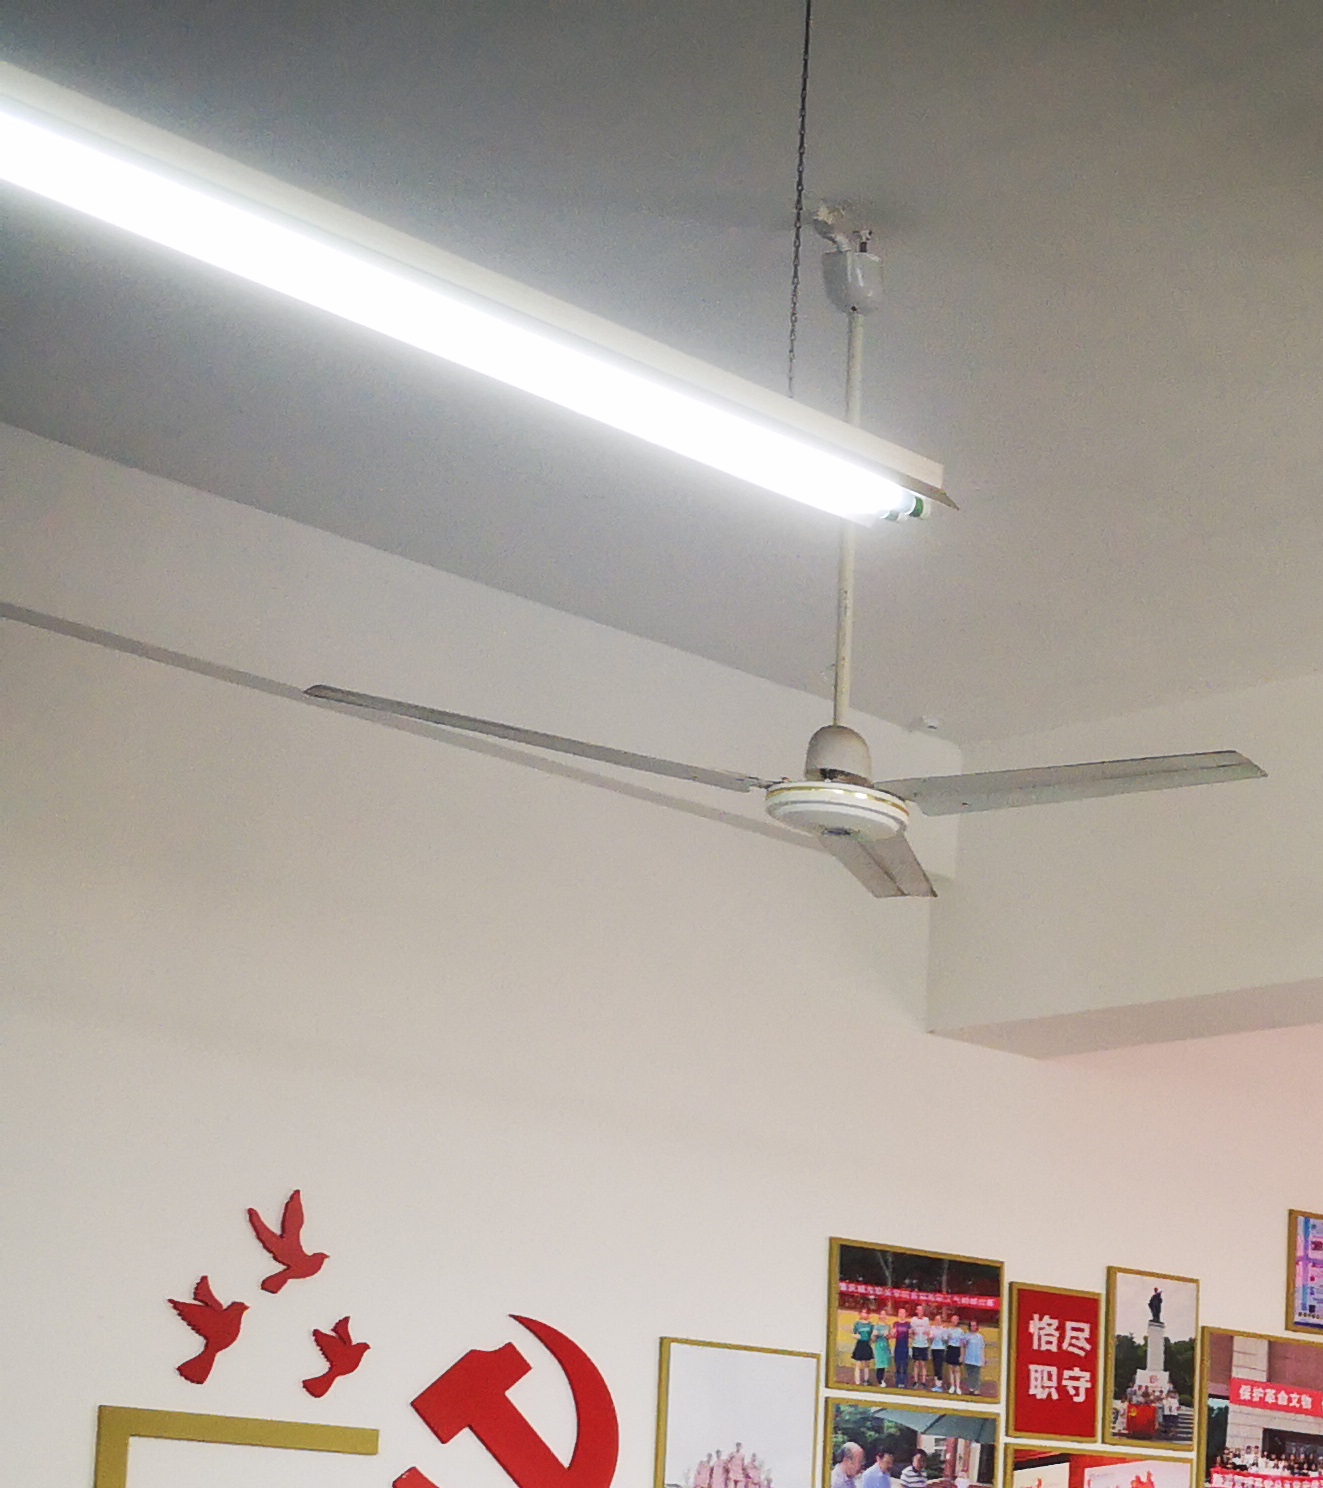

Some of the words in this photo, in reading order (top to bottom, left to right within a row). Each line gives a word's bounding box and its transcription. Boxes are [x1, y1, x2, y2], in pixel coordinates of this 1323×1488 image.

[1028, 1313, 1093, 1357] 恪尽
[1028, 1364, 1093, 1403] 职守
[1239, 1384, 1313, 1409] 保护革命文物
